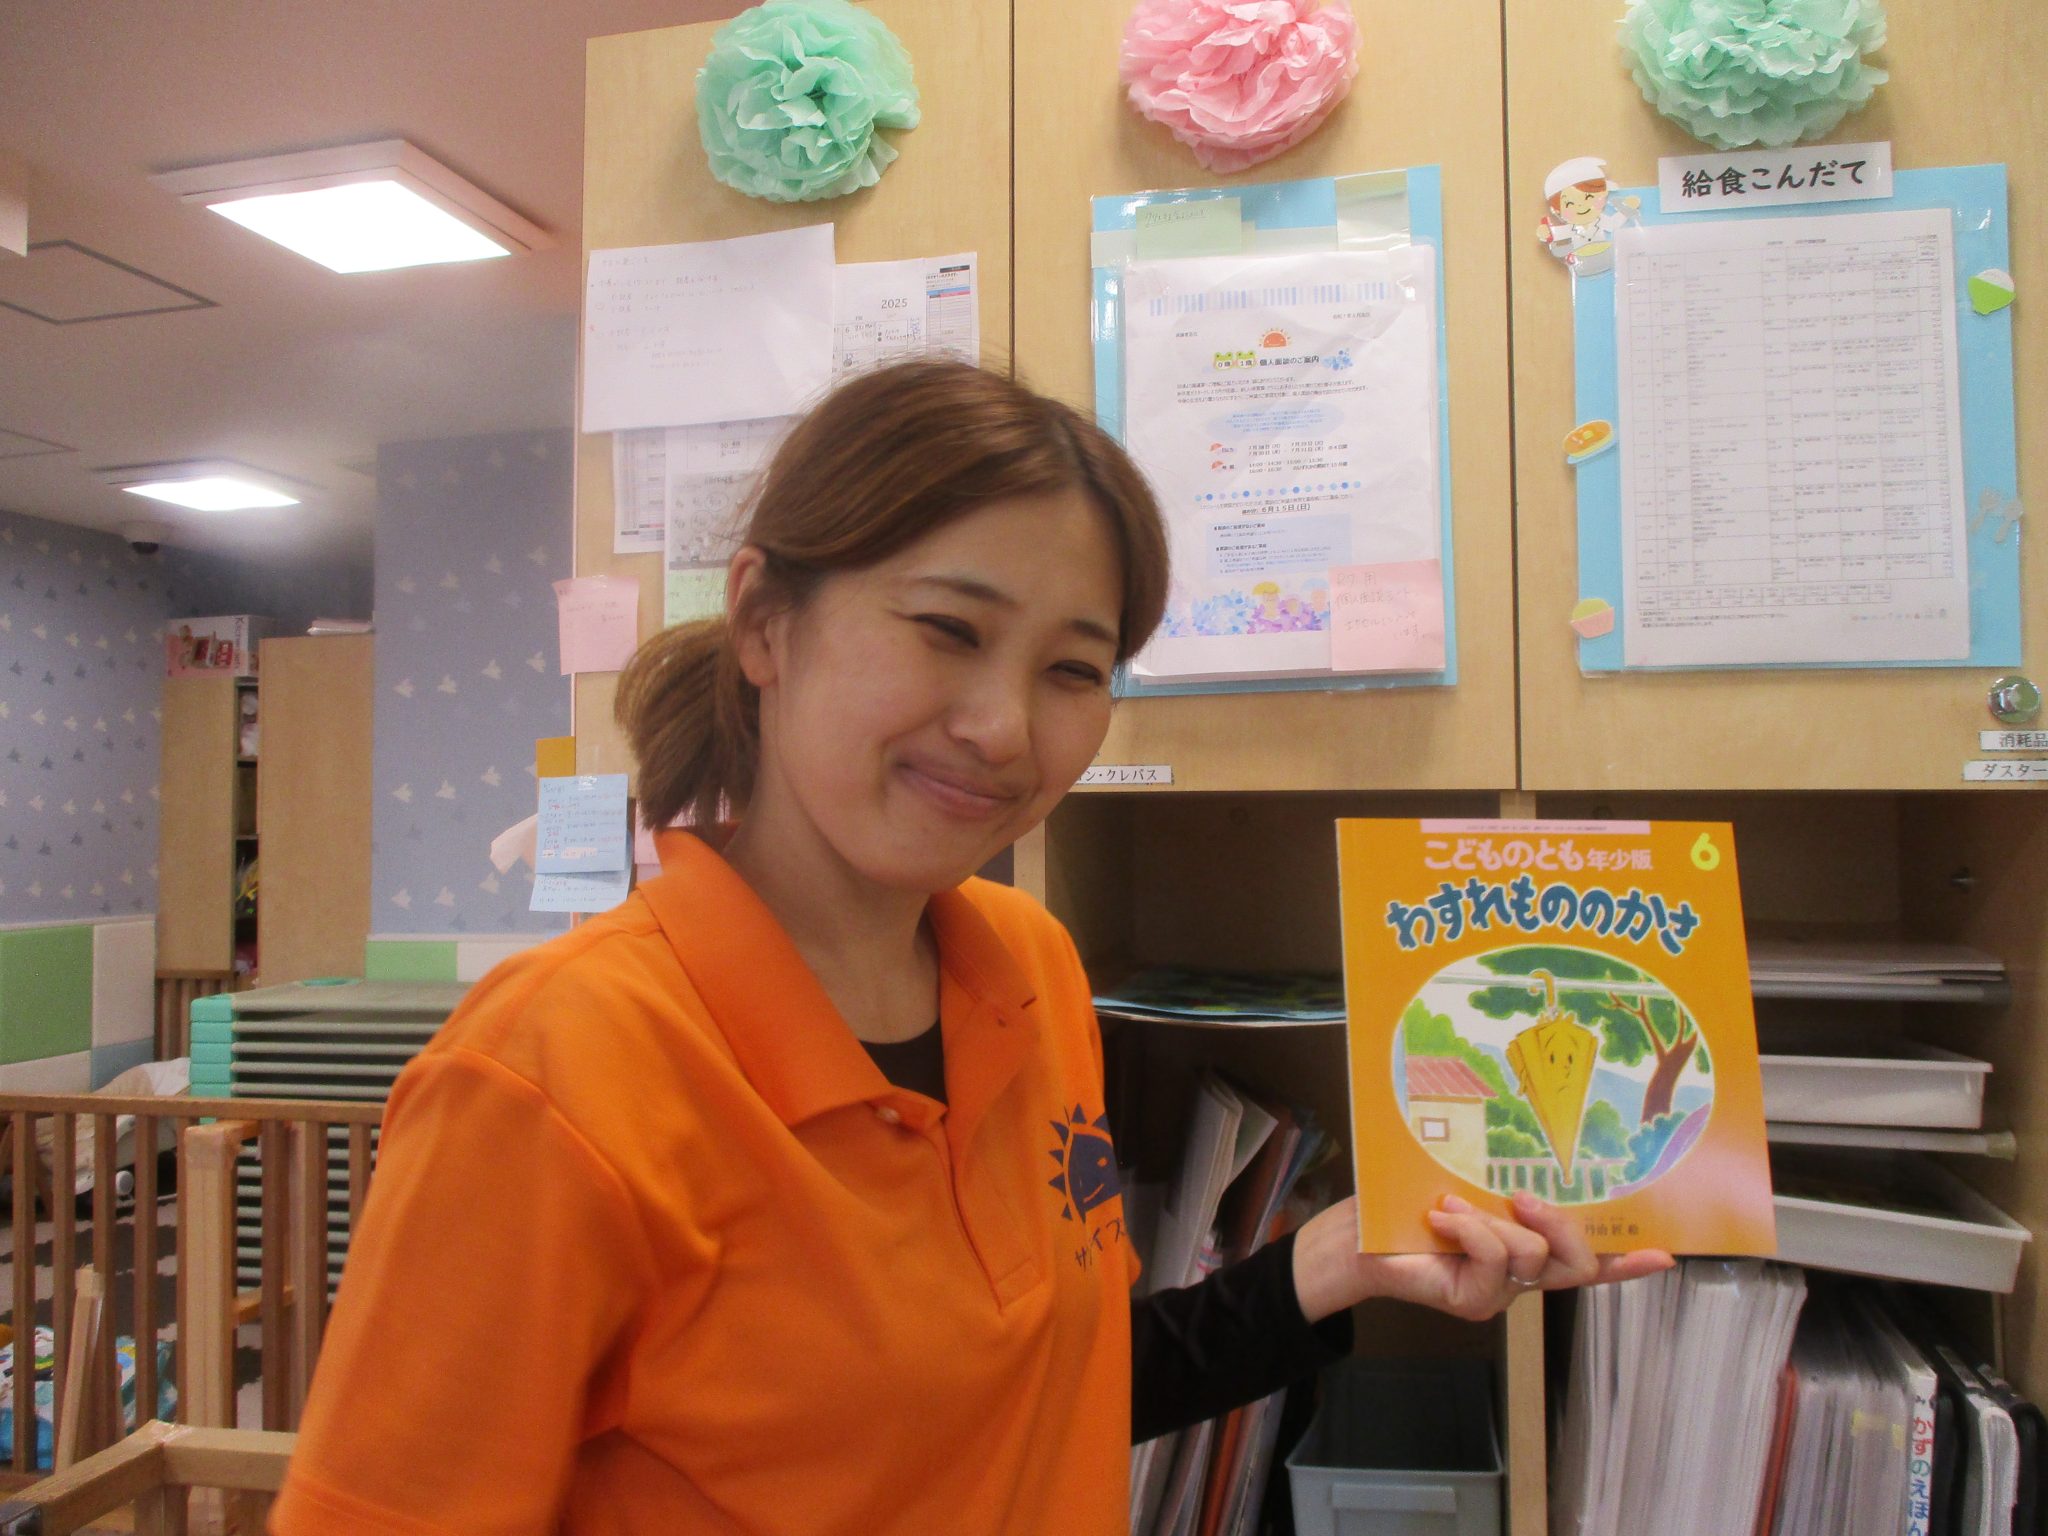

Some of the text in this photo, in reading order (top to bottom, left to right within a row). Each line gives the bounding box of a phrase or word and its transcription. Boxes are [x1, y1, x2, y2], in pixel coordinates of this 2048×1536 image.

[1681, 159, 1867, 199] 給食こんだて
[881, 297, 908, 309] 2025
[1999, 733, 2048, 748] 消耗品
[1984, 763, 2048, 778] ダスター
[1424, 838, 1654, 870] こどものとも年少版
[1690, 832, 1721, 870] 6
[1386, 873, 1700, 956] わすれもののかさ
